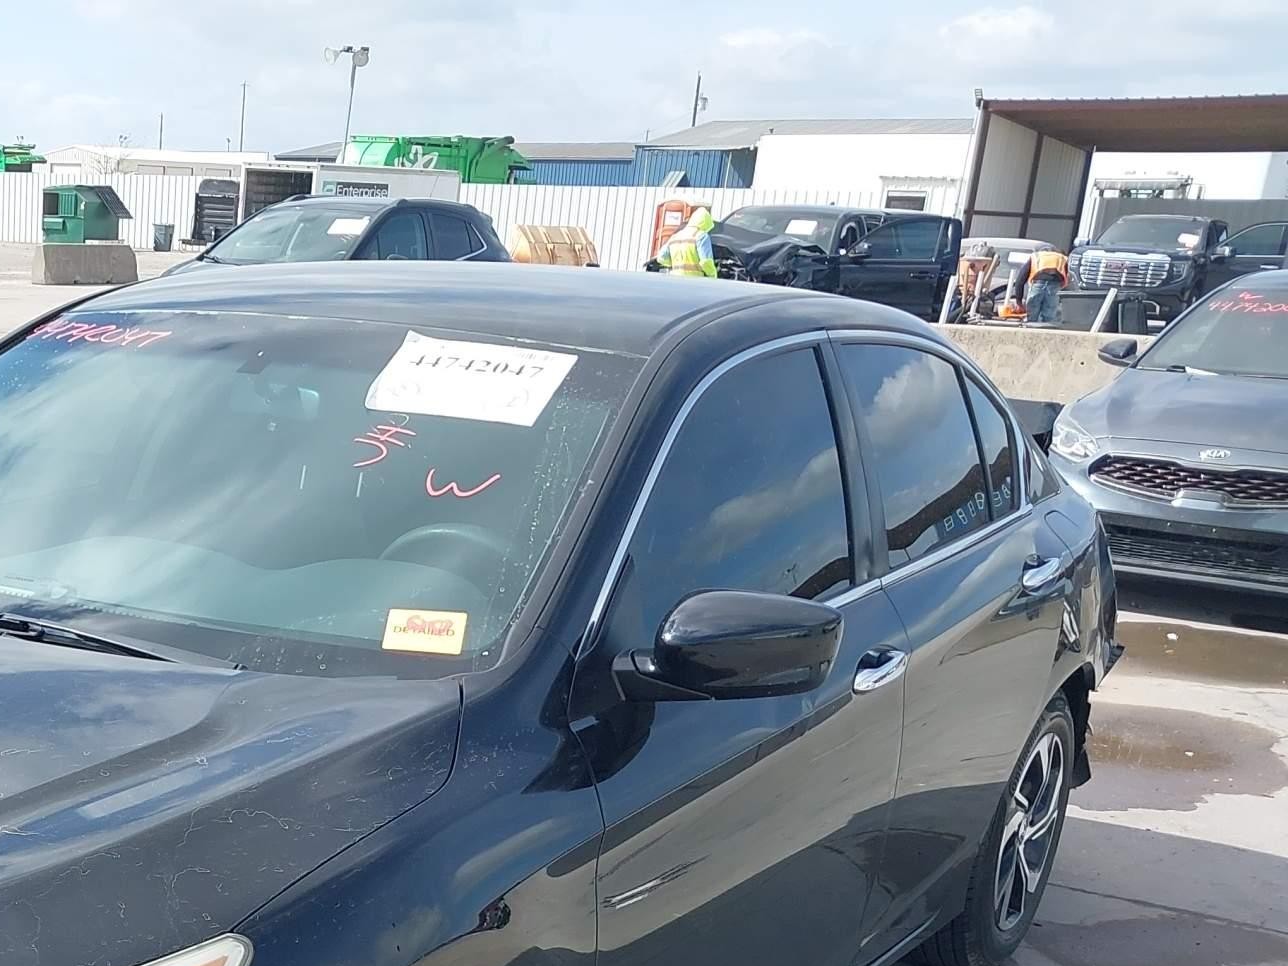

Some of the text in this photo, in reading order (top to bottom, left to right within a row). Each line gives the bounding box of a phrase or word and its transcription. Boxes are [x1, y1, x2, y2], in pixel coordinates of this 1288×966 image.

[336, 184, 389, 199] Enterprise
[409, 354, 545, 378] 44742047
[393, 625, 455, 637] DETAILED
